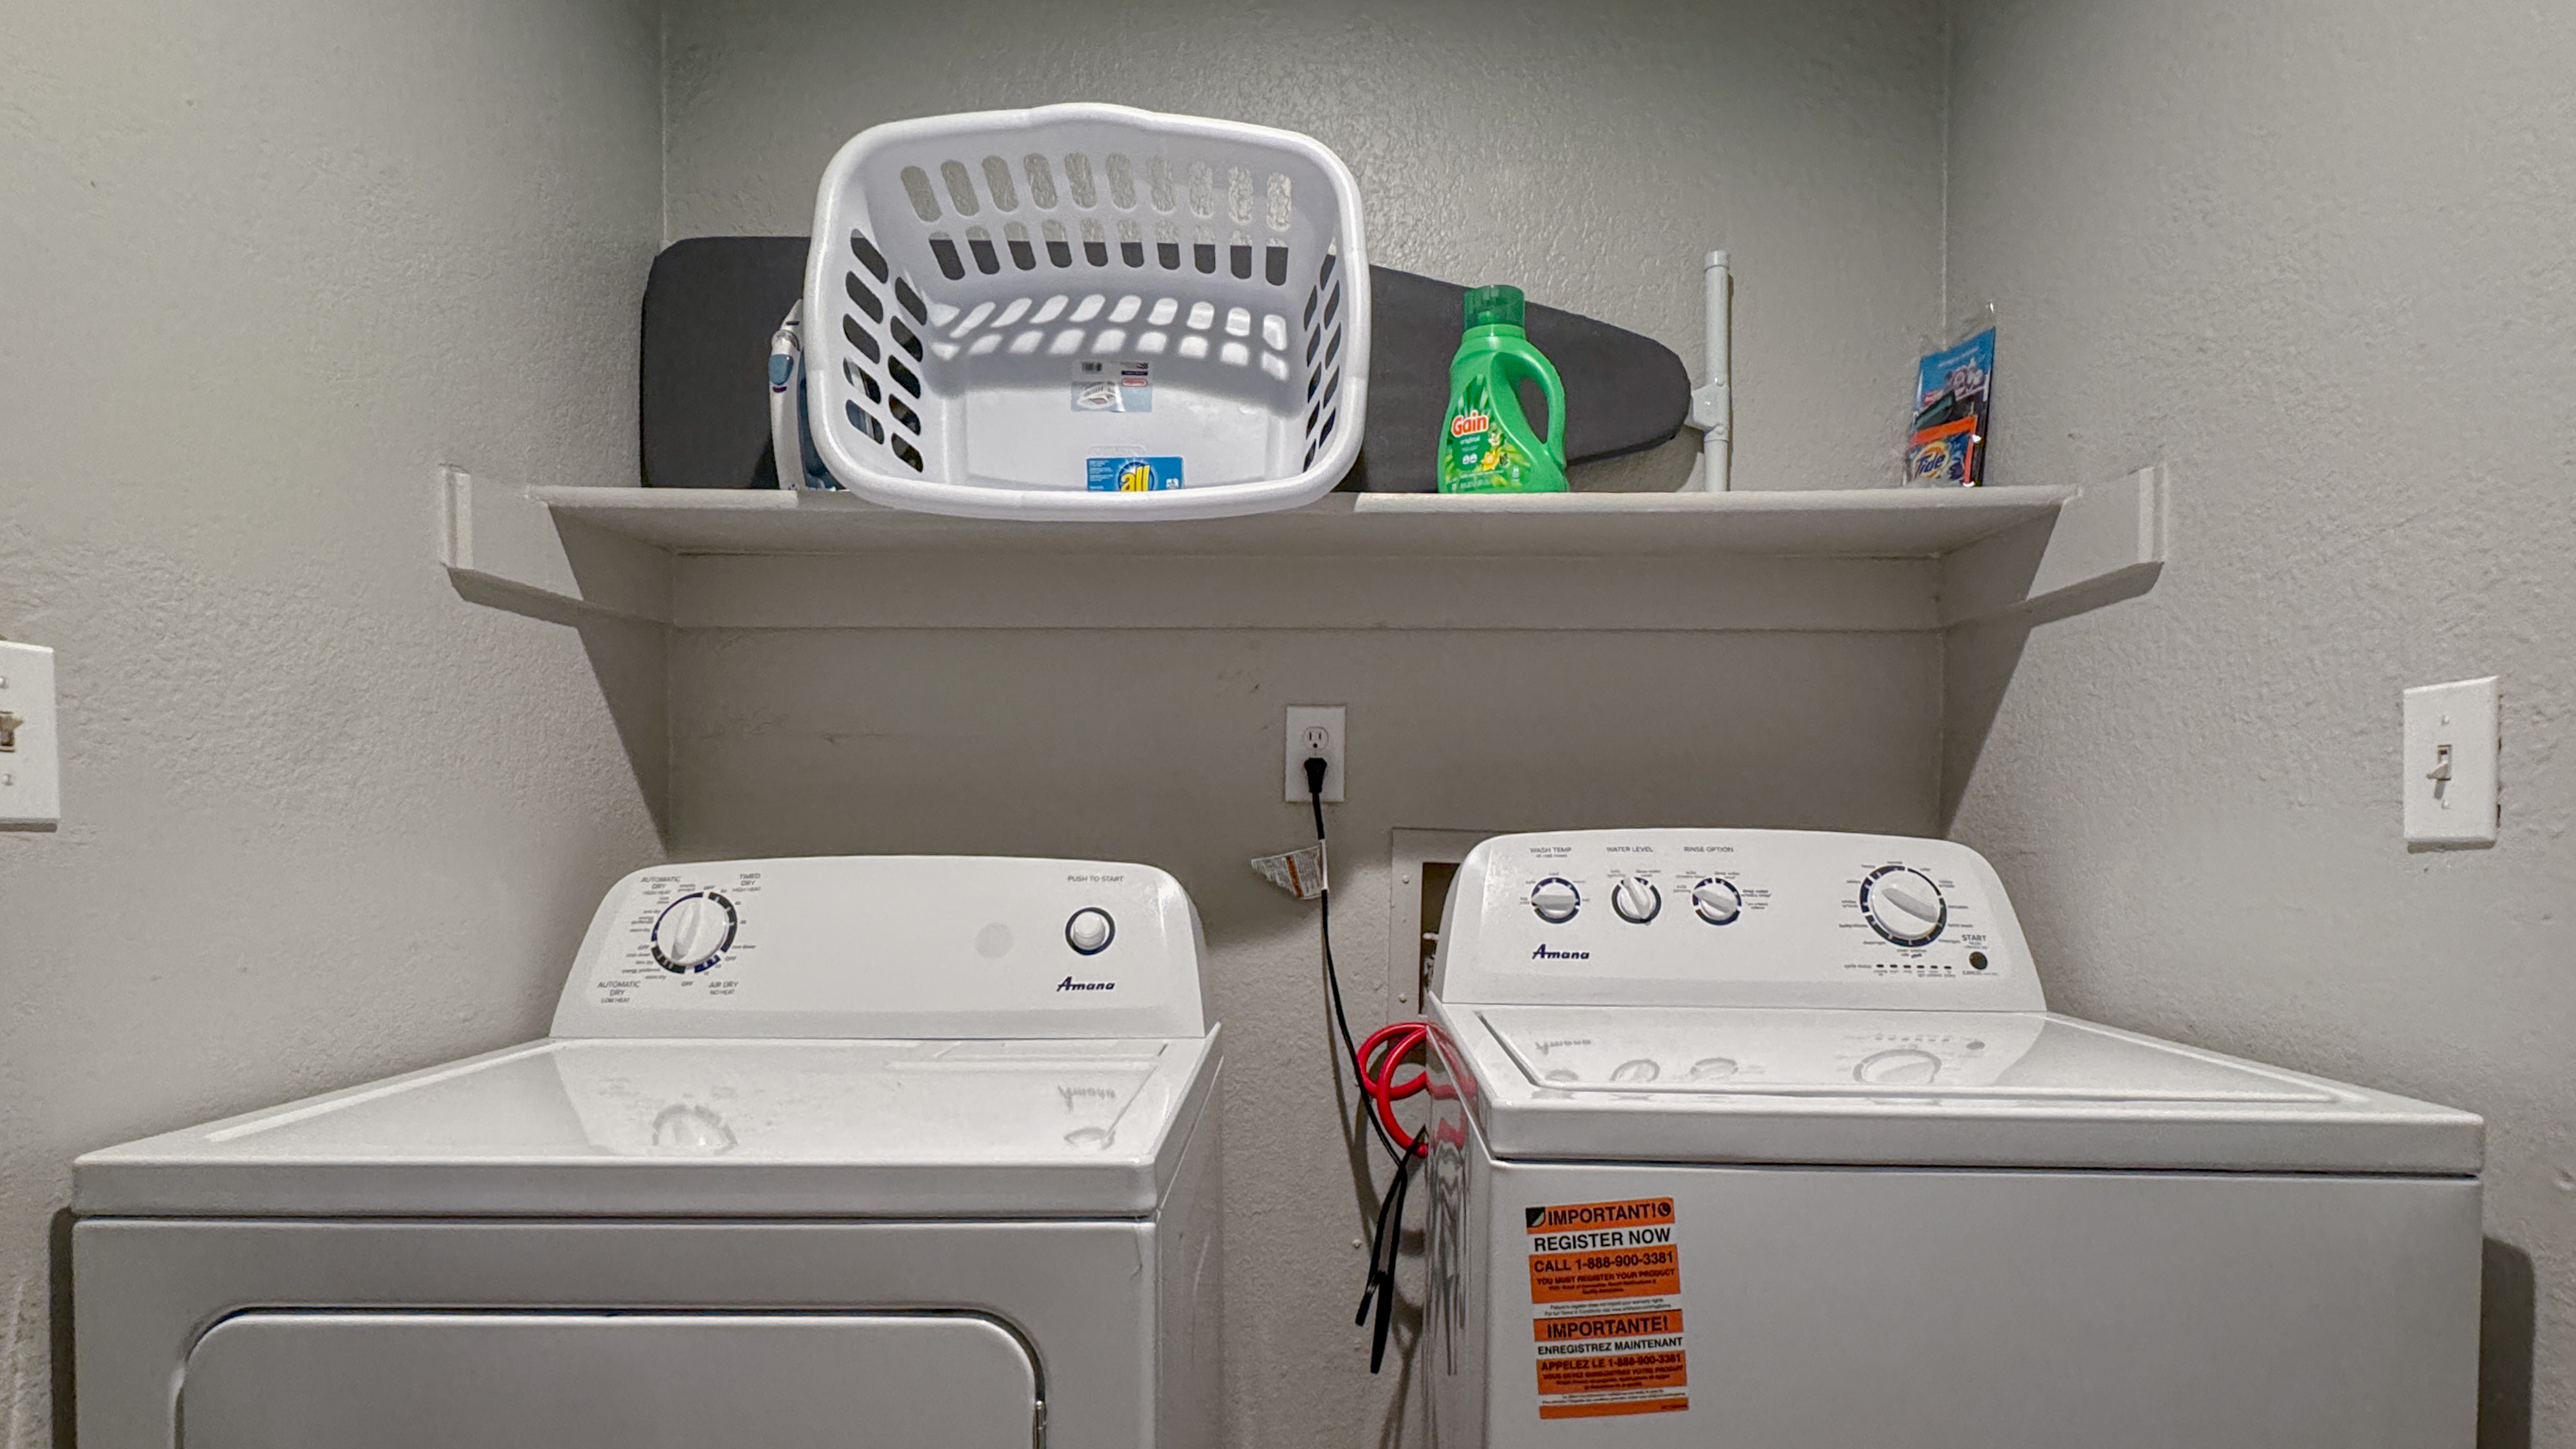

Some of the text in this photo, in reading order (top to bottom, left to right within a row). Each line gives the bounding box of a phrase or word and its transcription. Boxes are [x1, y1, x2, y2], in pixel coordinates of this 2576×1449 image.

[1452, 410, 1488, 437] Gain
[1915, 452, 1947, 478] Tide
[1121, 465, 1150, 492] all
[1532, 943, 1589, 960] Amana
[1056, 976, 1115, 992] Amana
[1548, 1203, 1656, 1226] IMPORTANT!
[1534, 1228, 1671, 1252] REGISTER NOW
[1534, 1252, 1674, 1273] CALL 1-888-900-3381
[1554, 1276, 1576, 1284] MUST
[1577, 1273, 1615, 1282] REGISTER
[1616, 1271, 1637, 1280] YOUR
[1639, 1269, 1675, 1278] PRODUCT
[1546, 1316, 1668, 1338] IMPORTANTE!
[1538, 1337, 1683, 1355] ENREGISTREZ MAINTENANT
[1541, 1360, 1589, 1371] APPELEZ
[1592, 1359, 1605, 1367] LE
